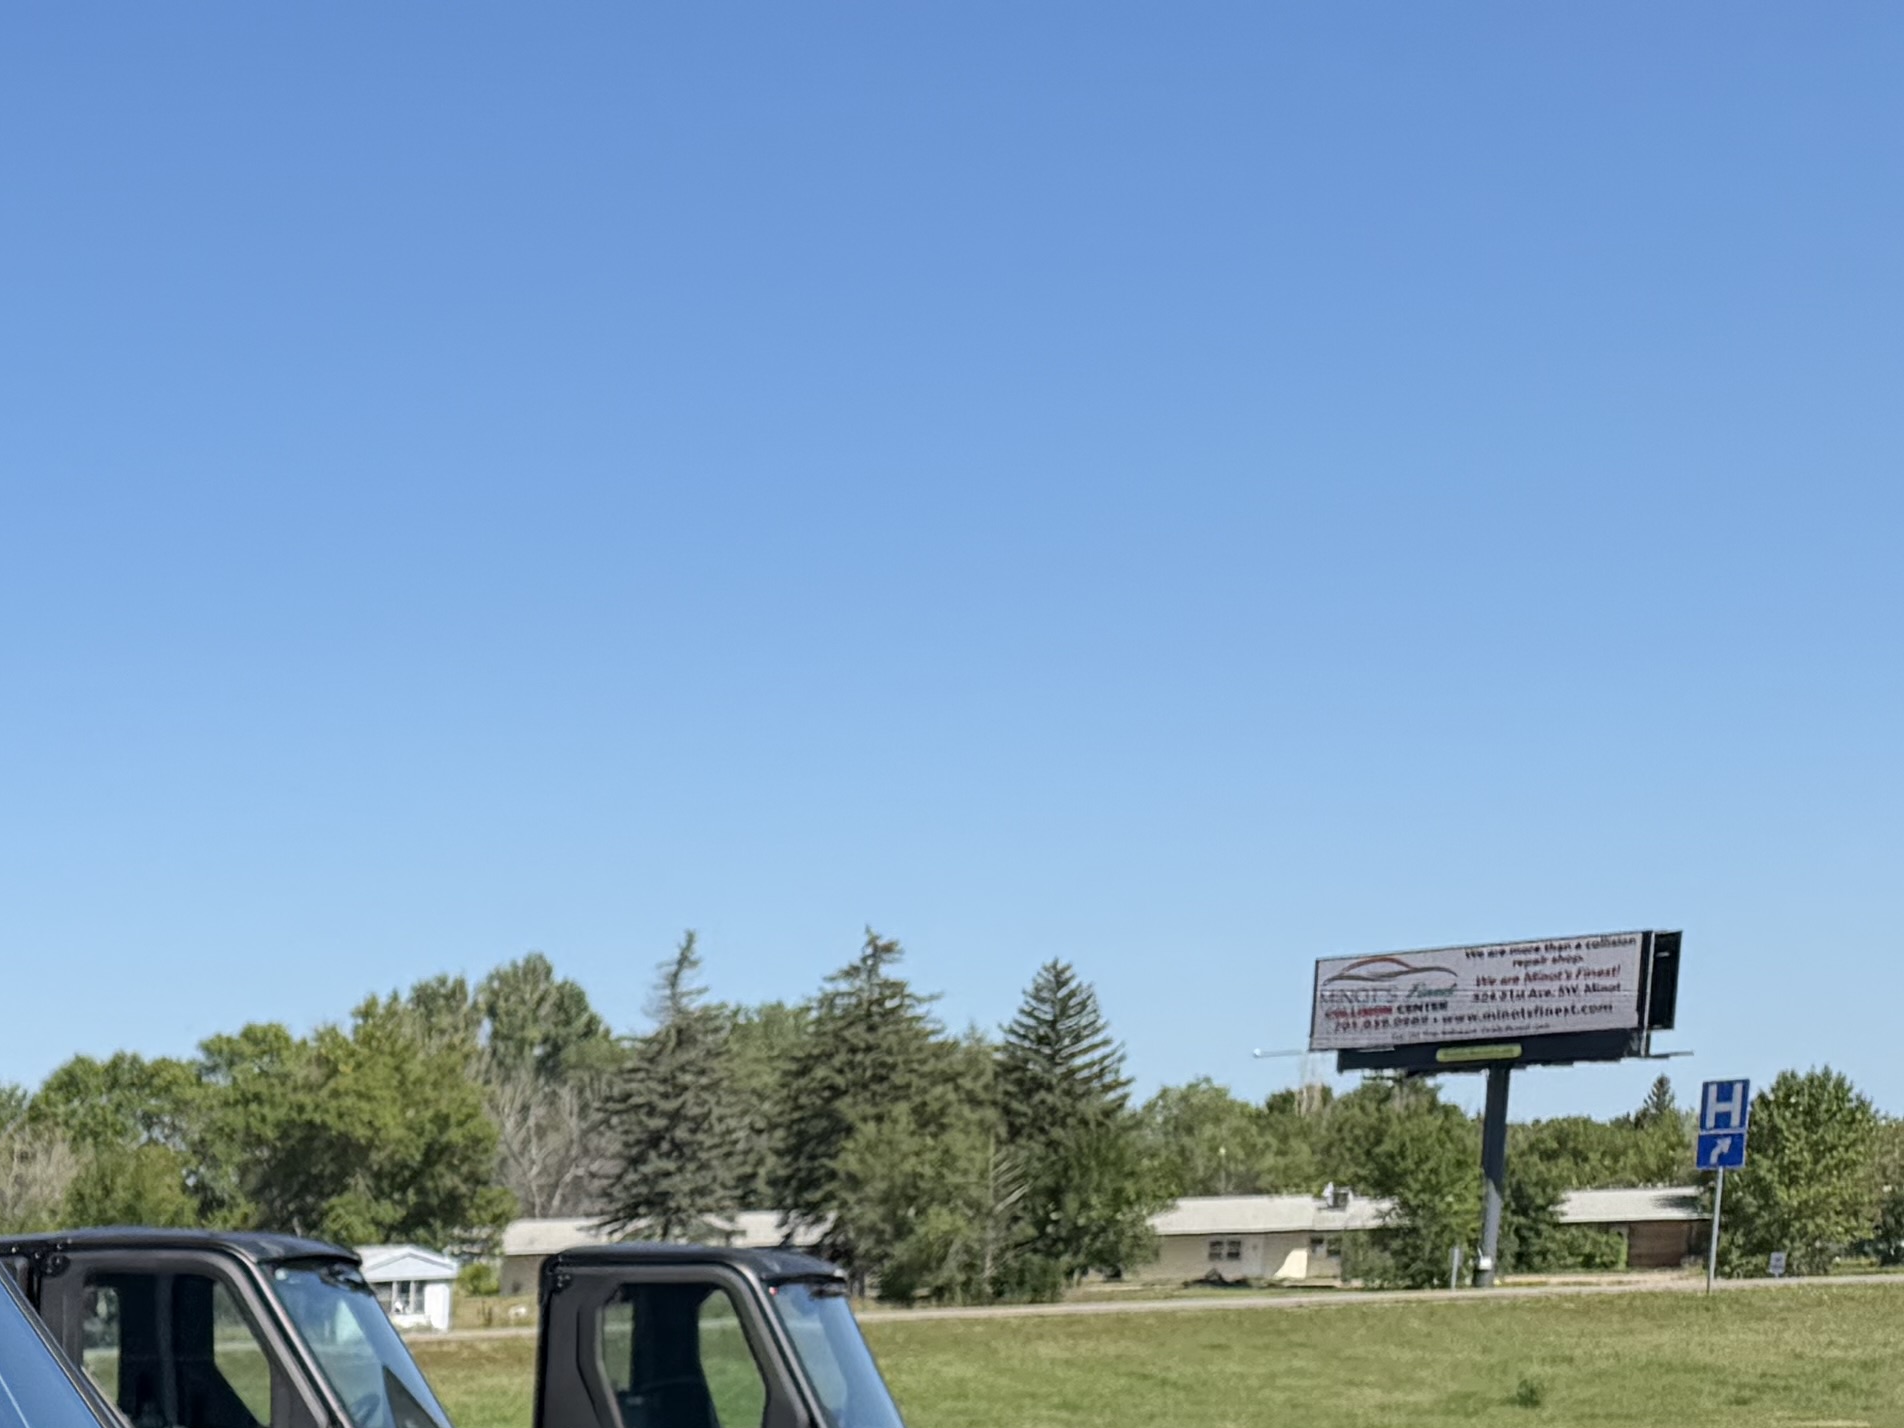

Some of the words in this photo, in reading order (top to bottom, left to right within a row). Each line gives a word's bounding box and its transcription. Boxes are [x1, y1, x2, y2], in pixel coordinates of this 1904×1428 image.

[1488, 947, 1506, 958] are
[1510, 944, 1540, 955] more
[1544, 941, 1572, 952] than
[1585, 935, 1636, 950] collision
[1512, 955, 1548, 969] repair
[1500, 976, 1520, 986] are
[1397, 1000, 1448, 1015] CENTER
[1706, 1084, 1743, 1129] H
